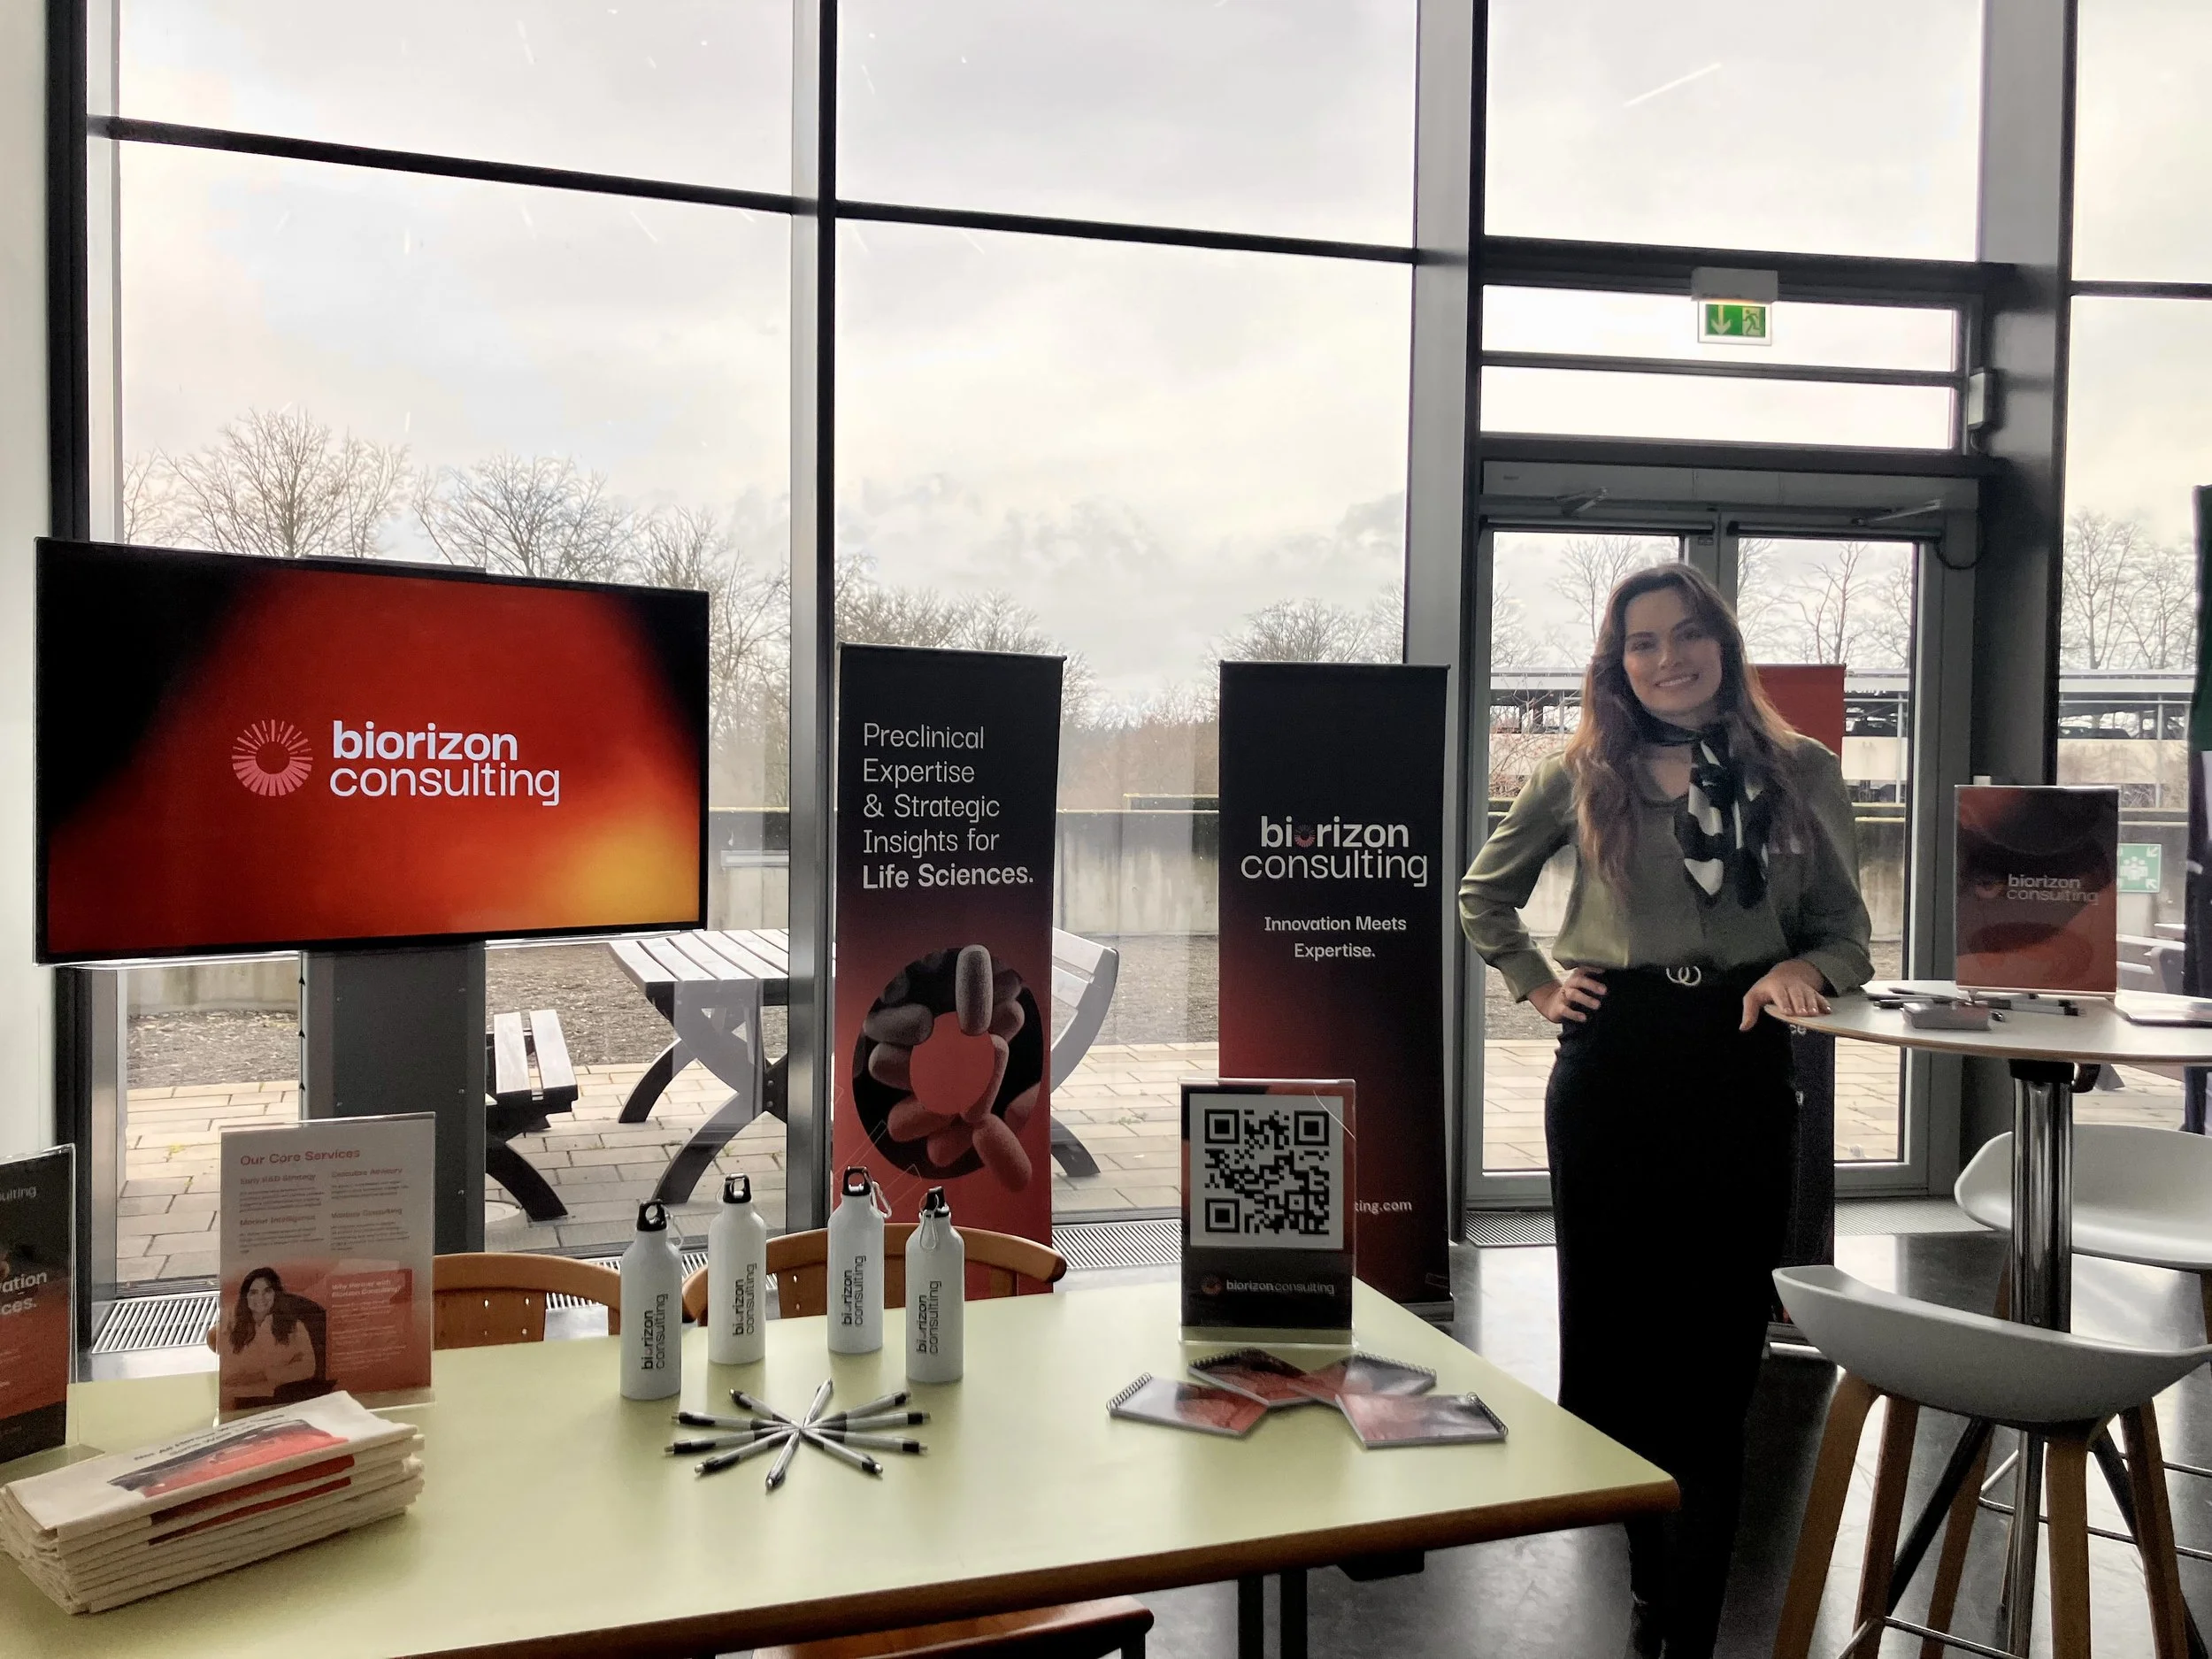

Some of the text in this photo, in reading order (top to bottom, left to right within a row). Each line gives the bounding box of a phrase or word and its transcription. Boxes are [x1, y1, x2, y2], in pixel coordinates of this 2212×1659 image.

[333, 719, 518, 761] biorizon
[863, 723, 985, 749] Preclinical
[329, 762, 561, 807] consulting
[863, 757, 975, 788] Expertise
[863, 793, 1001, 824] & Strategic
[863, 827, 1000, 858] Insights for
[862, 862, 1033, 889] Life Sciences.
[1240, 849, 1428, 887] consulting
[2008, 873, 2080, 888] biorizon
[2006, 888, 2099, 906] consulting
[1264, 916, 1407, 933] Innovation Meets
[1294, 942, 1376, 961] Expertise.
[240, 1149, 361, 1166] Our Core Services
[746, 1263, 757, 1336] consulting
[855, 1255, 867, 1326] consulting
[656, 1294, 669, 1370] consulting
[929, 1280, 942, 1355] consulting
